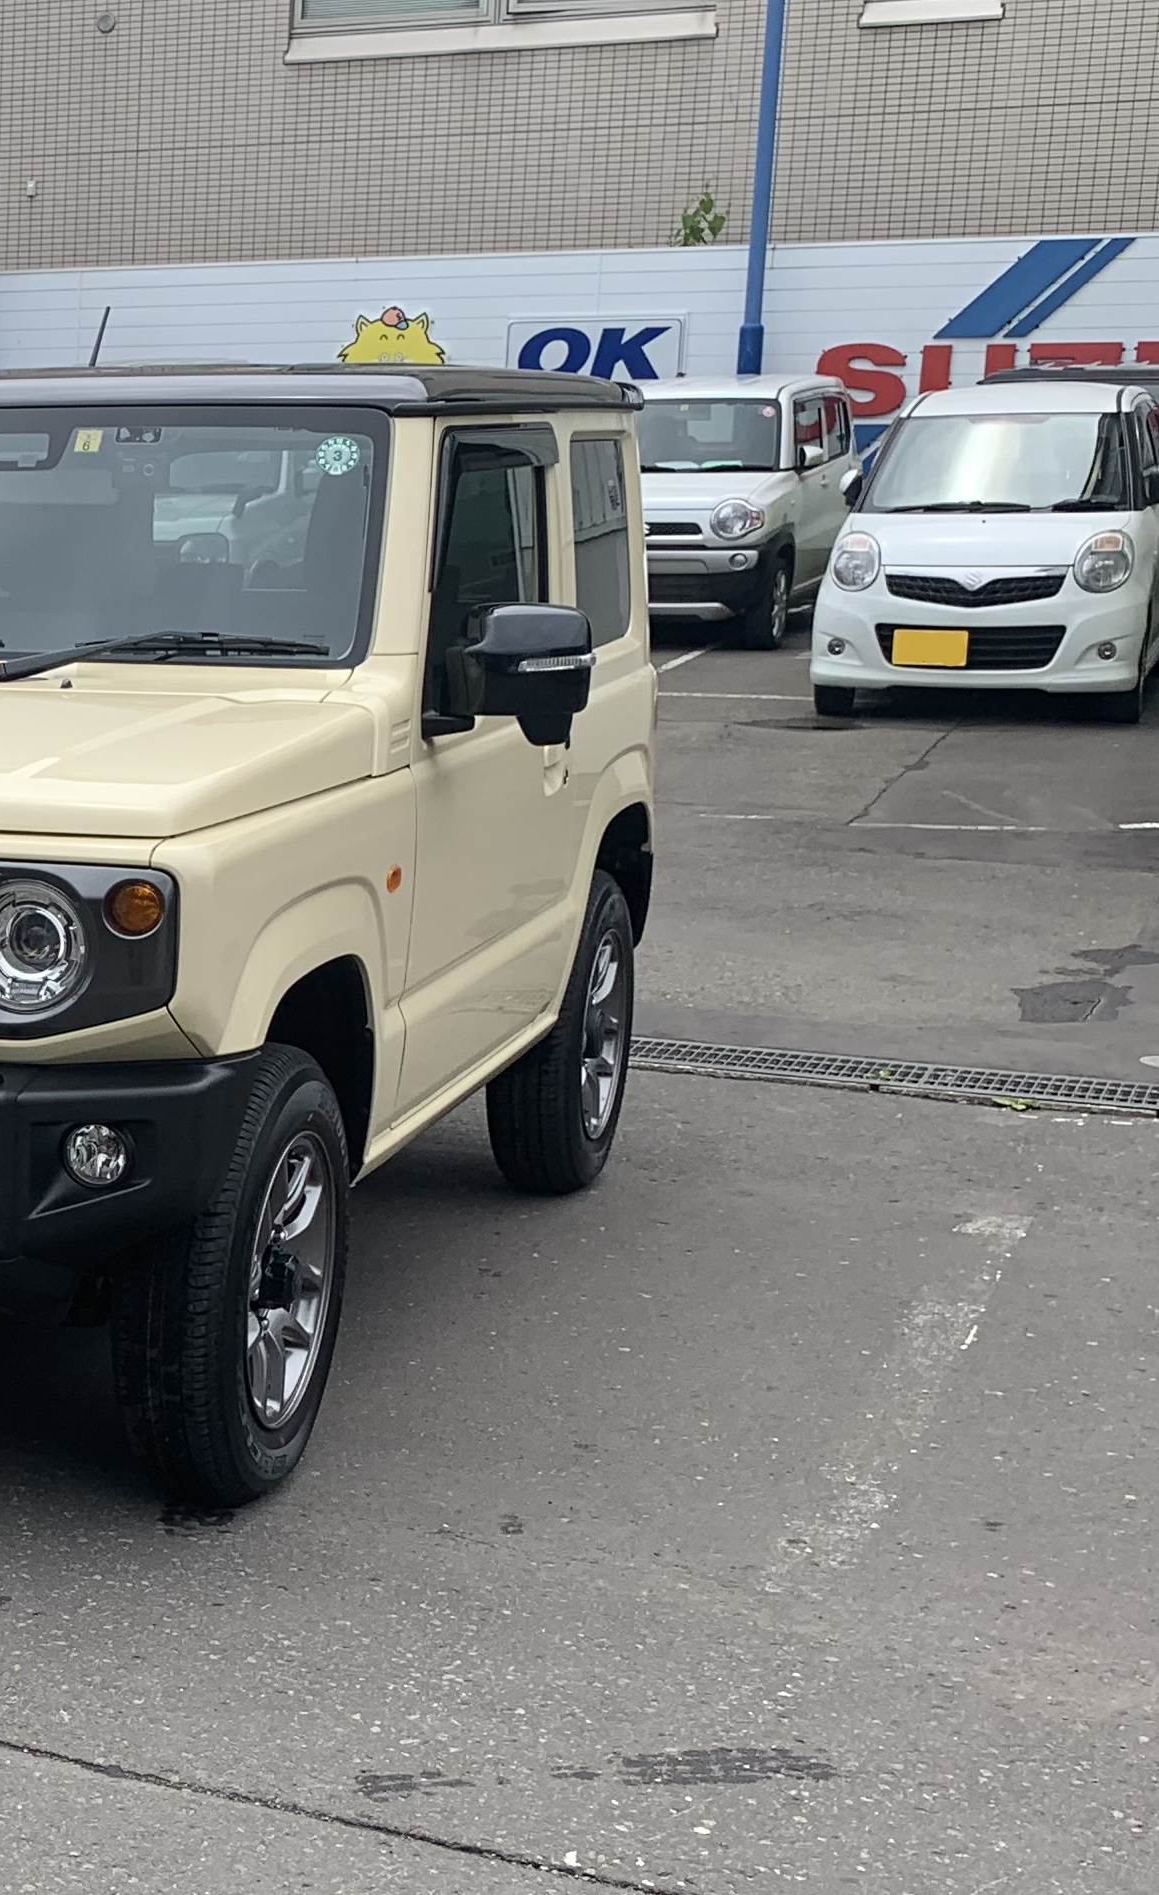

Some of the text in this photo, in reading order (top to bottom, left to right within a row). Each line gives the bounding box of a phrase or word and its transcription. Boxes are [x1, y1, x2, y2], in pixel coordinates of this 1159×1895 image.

[517, 327, 673, 380] OK
[82, 440, 91, 451] 6
[332, 450, 342, 461] 3
